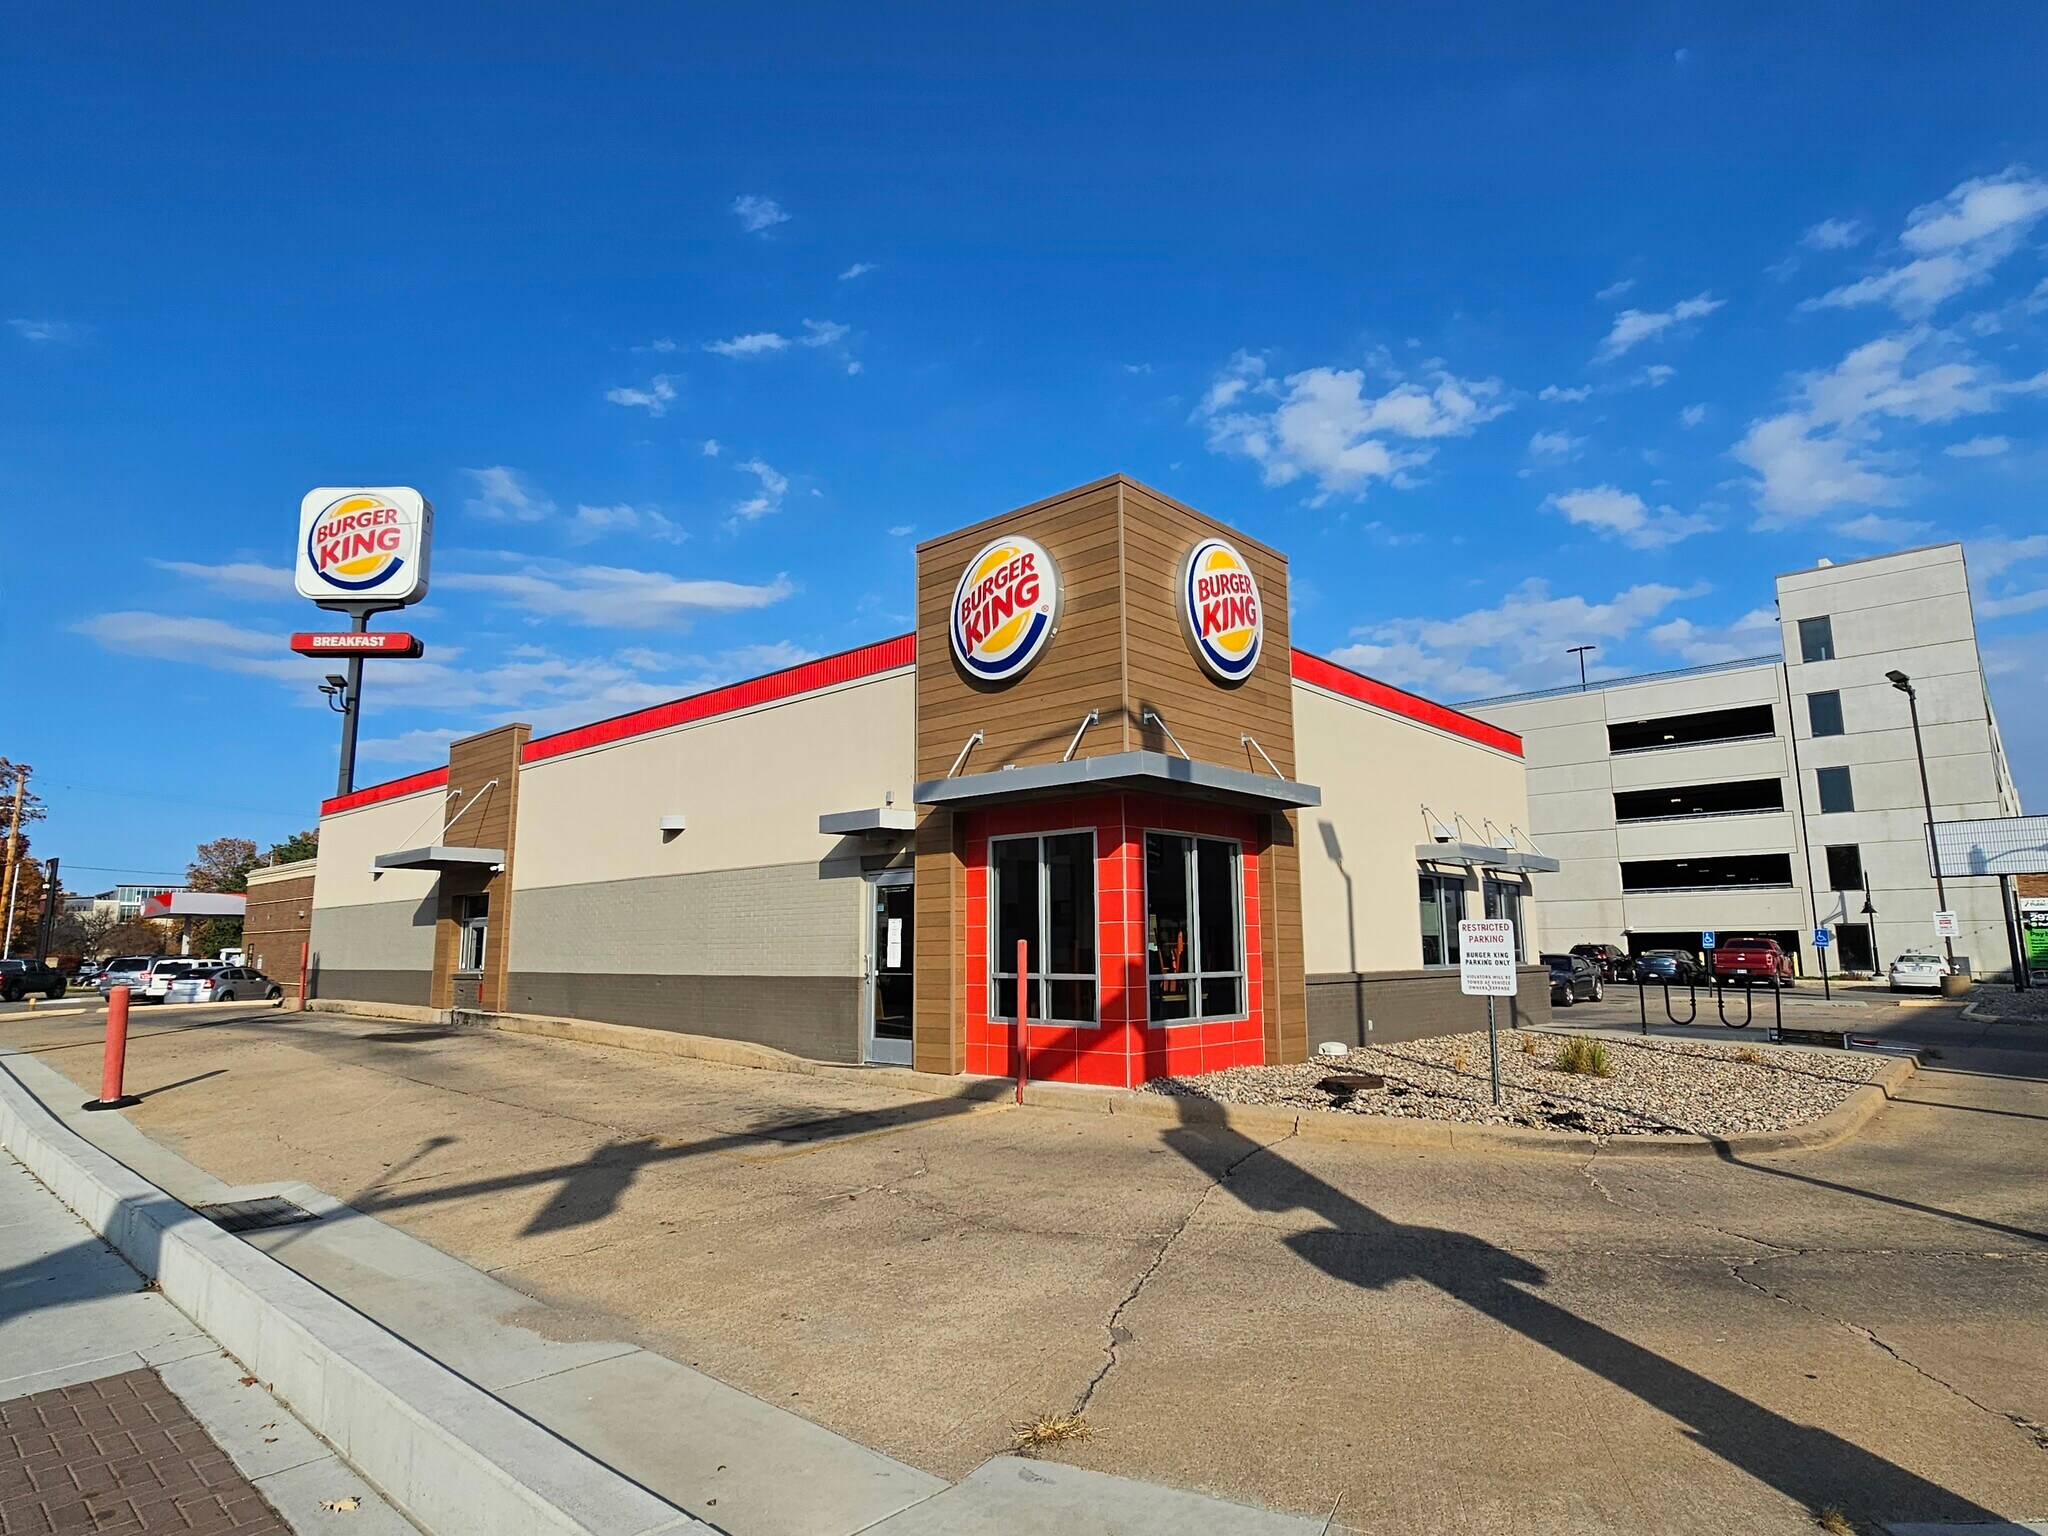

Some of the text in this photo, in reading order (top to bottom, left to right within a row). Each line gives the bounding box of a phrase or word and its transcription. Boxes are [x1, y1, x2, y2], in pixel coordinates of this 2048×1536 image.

[317, 508, 398, 545] BURGER
[319, 527, 401, 571] KING
[961, 552, 1035, 624] BURGER
[1198, 573, 1253, 603] BURGER
[964, 573, 1040, 657] KING
[1201, 596, 1257, 639] KING
[312, 636, 386, 647] BREAKFAST
